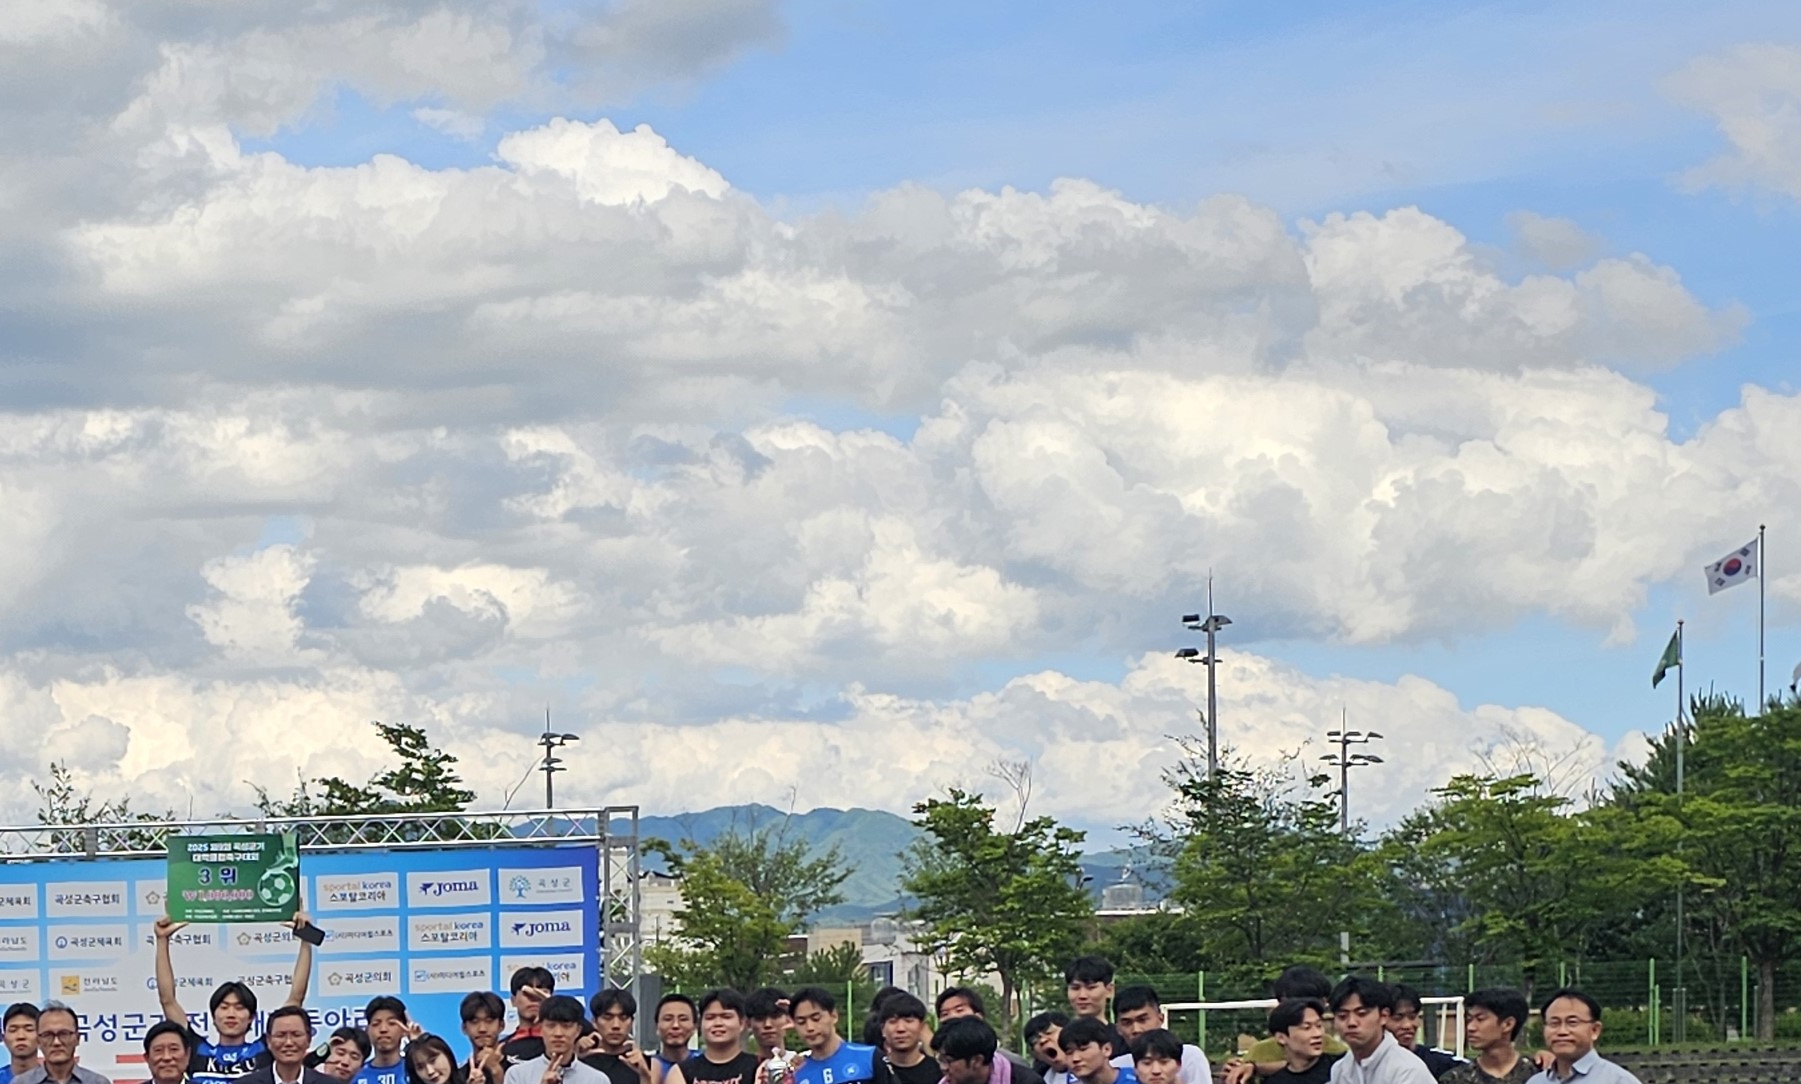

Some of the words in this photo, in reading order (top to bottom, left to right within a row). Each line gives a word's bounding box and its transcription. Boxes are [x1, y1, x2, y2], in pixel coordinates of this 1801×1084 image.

[362, 880, 392, 890] korea
[329, 890, 386, 902] 스포탈코리아
[454, 921, 484, 931] korea
[421, 931, 478, 943] 스포탈코리아
[345, 971, 391, 983] 곡성군의회
[822, 1068, 834, 1084] 6
